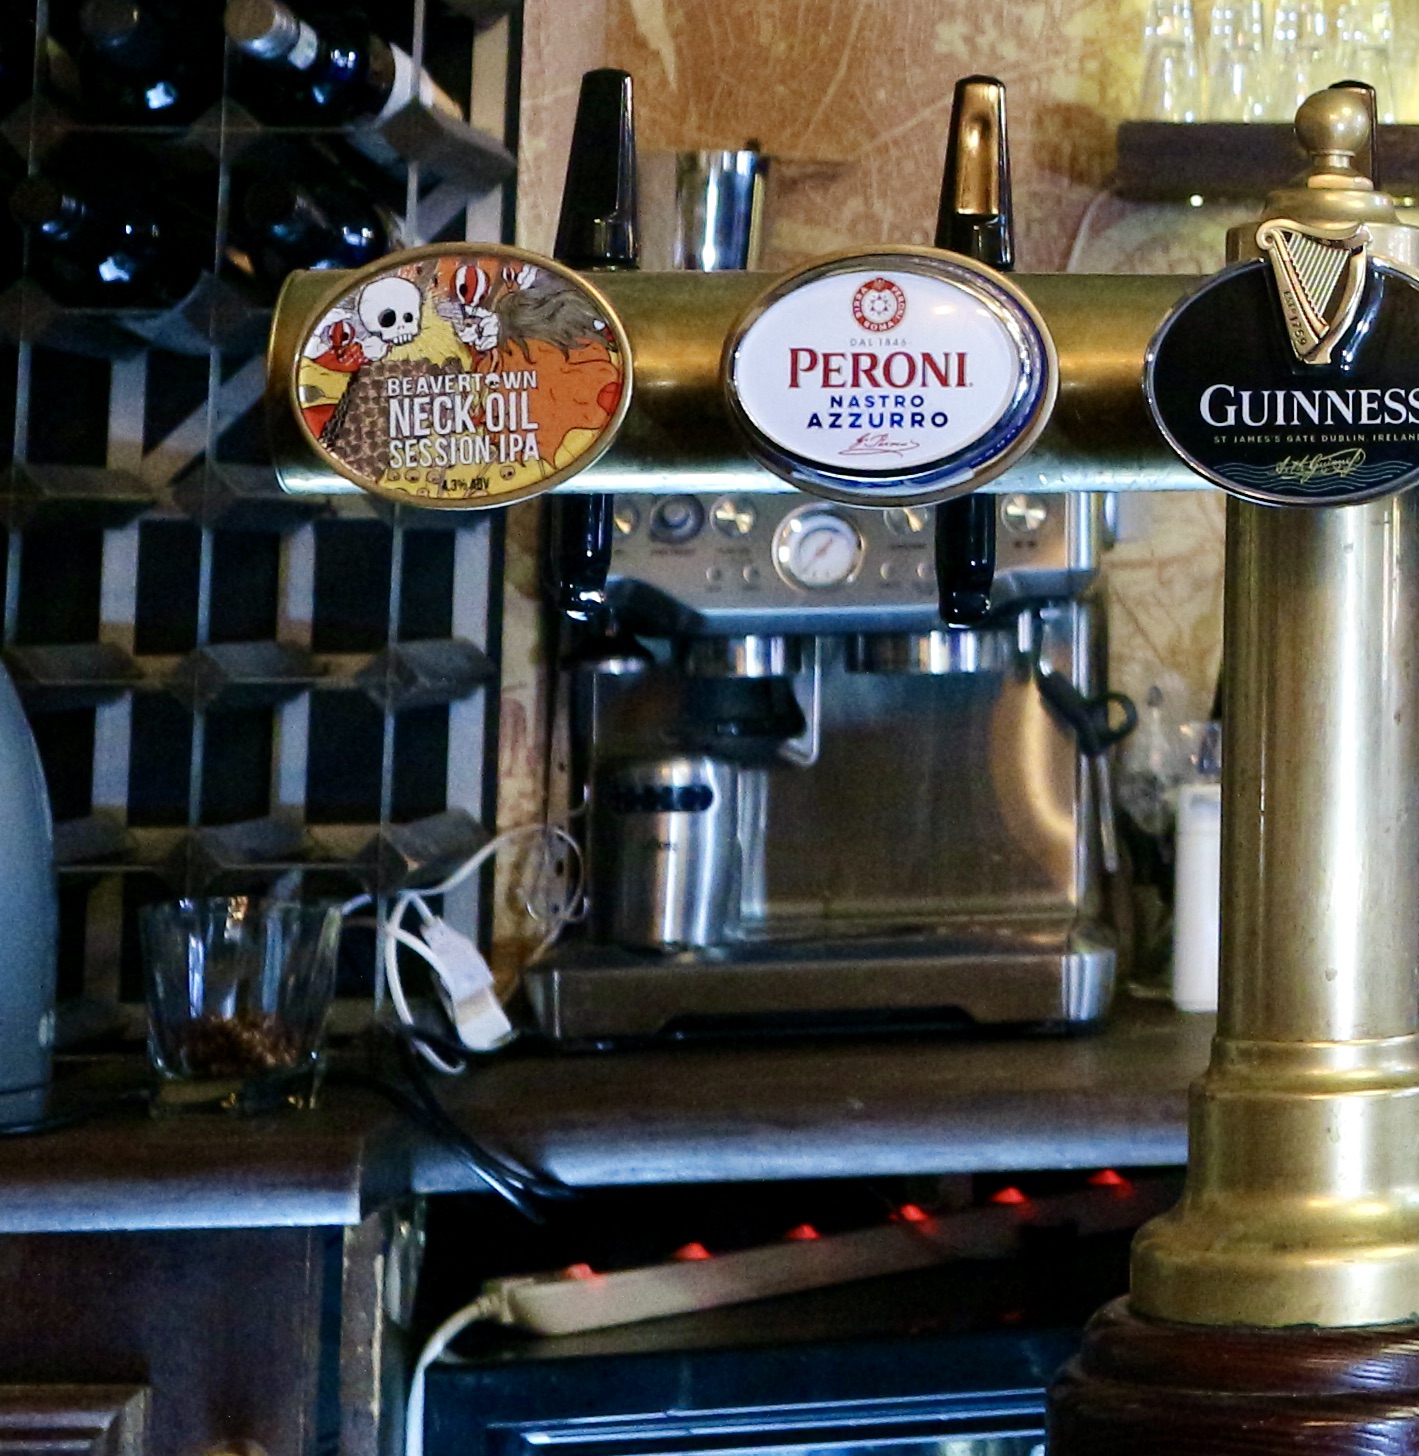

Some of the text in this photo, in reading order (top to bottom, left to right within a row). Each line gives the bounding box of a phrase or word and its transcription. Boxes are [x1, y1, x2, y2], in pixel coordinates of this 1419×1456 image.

[850, 338, 908, 347] DAL 1846
[788, 347, 970, 389] PERONI
[829, 394, 926, 409] NASTRO
[389, 390, 539, 439] NECK OIL
[806, 411, 949, 429] AZZURRO
[1286, 434, 1316, 444] GATE
[389, 431, 540, 470] SESSION IPA
